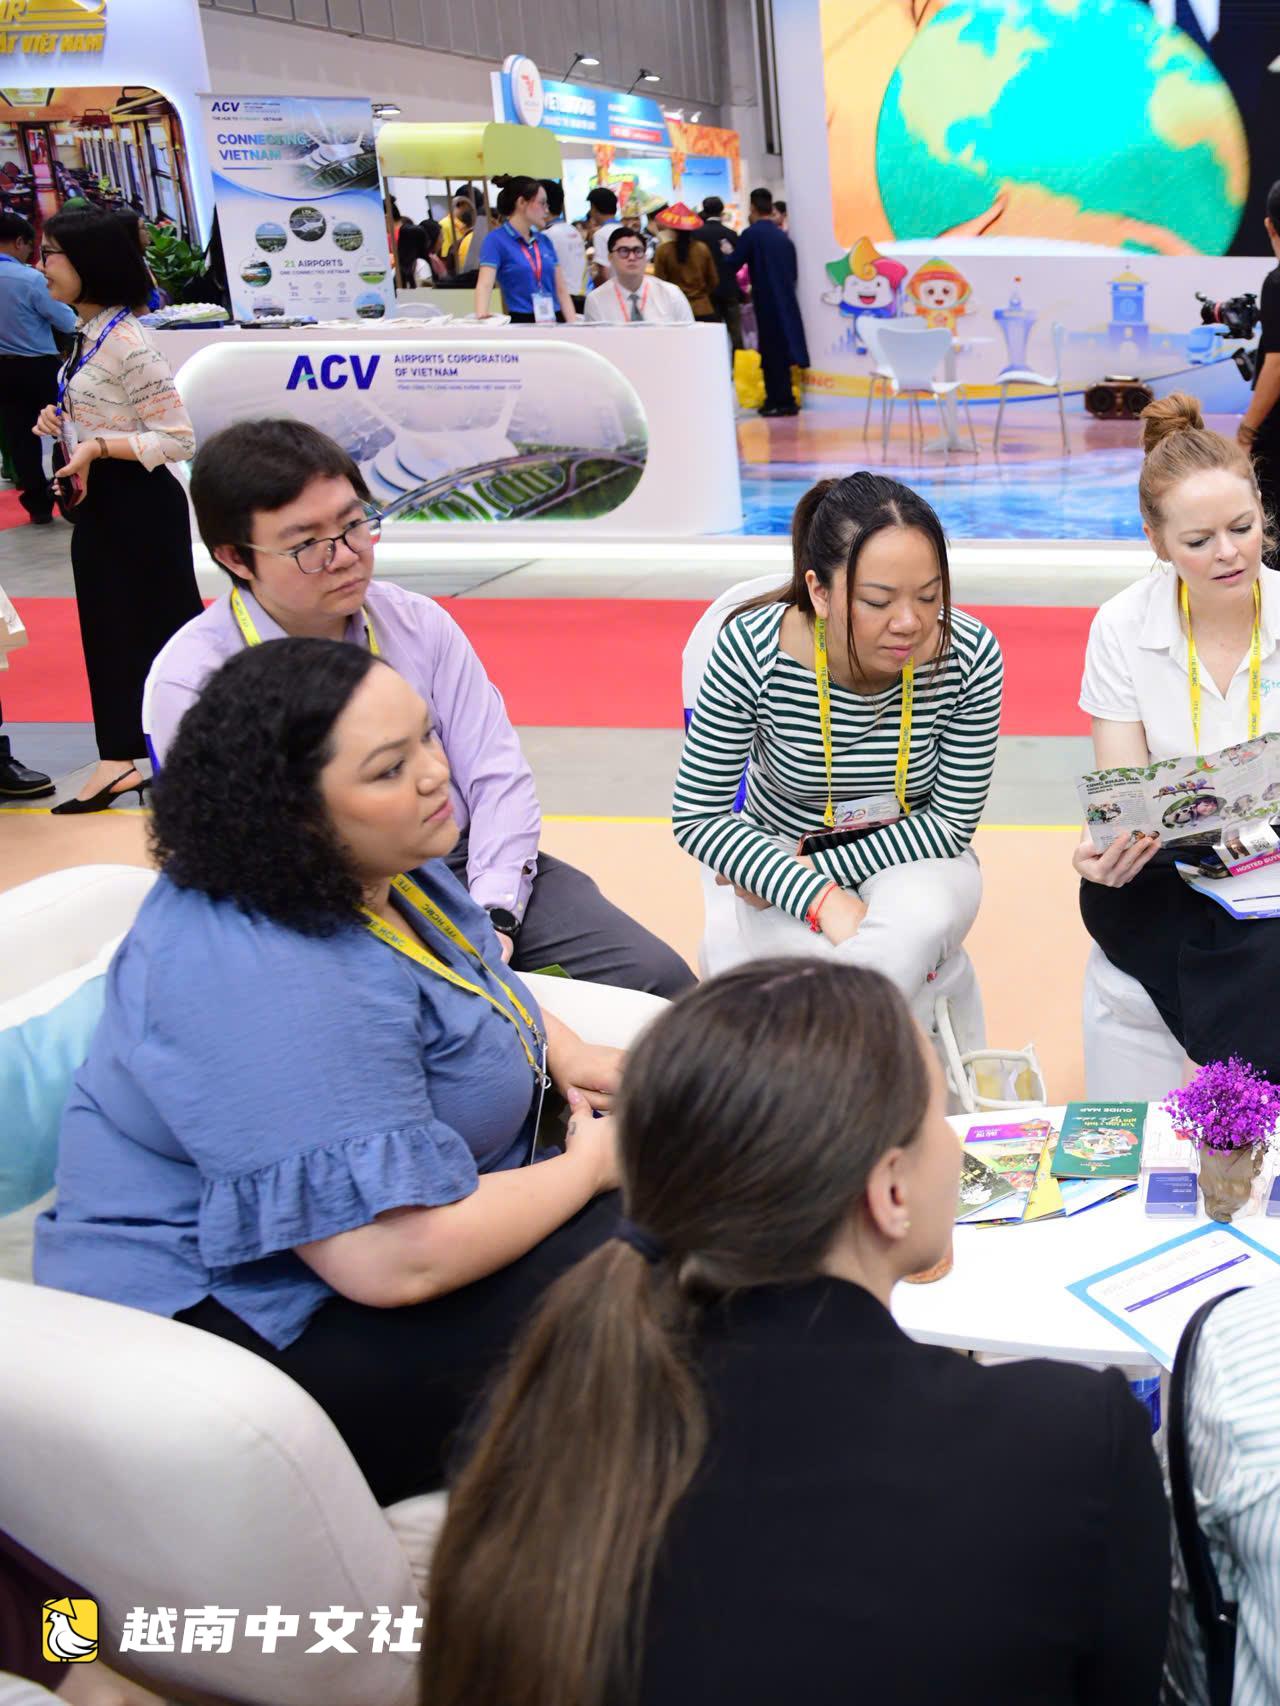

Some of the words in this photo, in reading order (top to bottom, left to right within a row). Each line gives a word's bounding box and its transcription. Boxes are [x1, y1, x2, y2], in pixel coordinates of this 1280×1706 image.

[61, 33, 105, 53] NAM
[211, 101, 240, 112] ACV
[217, 133, 308, 145] CONNECTING
[219, 150, 282, 161] VIETNAM
[284, 260, 296, 268] 21
[298, 259, 343, 268] AIRPORTS
[394, 354, 445, 364] AIRPORTS
[446, 353, 520, 364] CORPORATION
[285, 354, 381, 390] ACV
[395, 367, 409, 377] OF
[411, 367, 458, 377] VIETNAM
[1236, 860, 1264, 873] HOSTED
[422, 903, 446, 926] HCMC
[379, 927, 406, 947] HCMC
[444, 925, 457, 938] ITE
